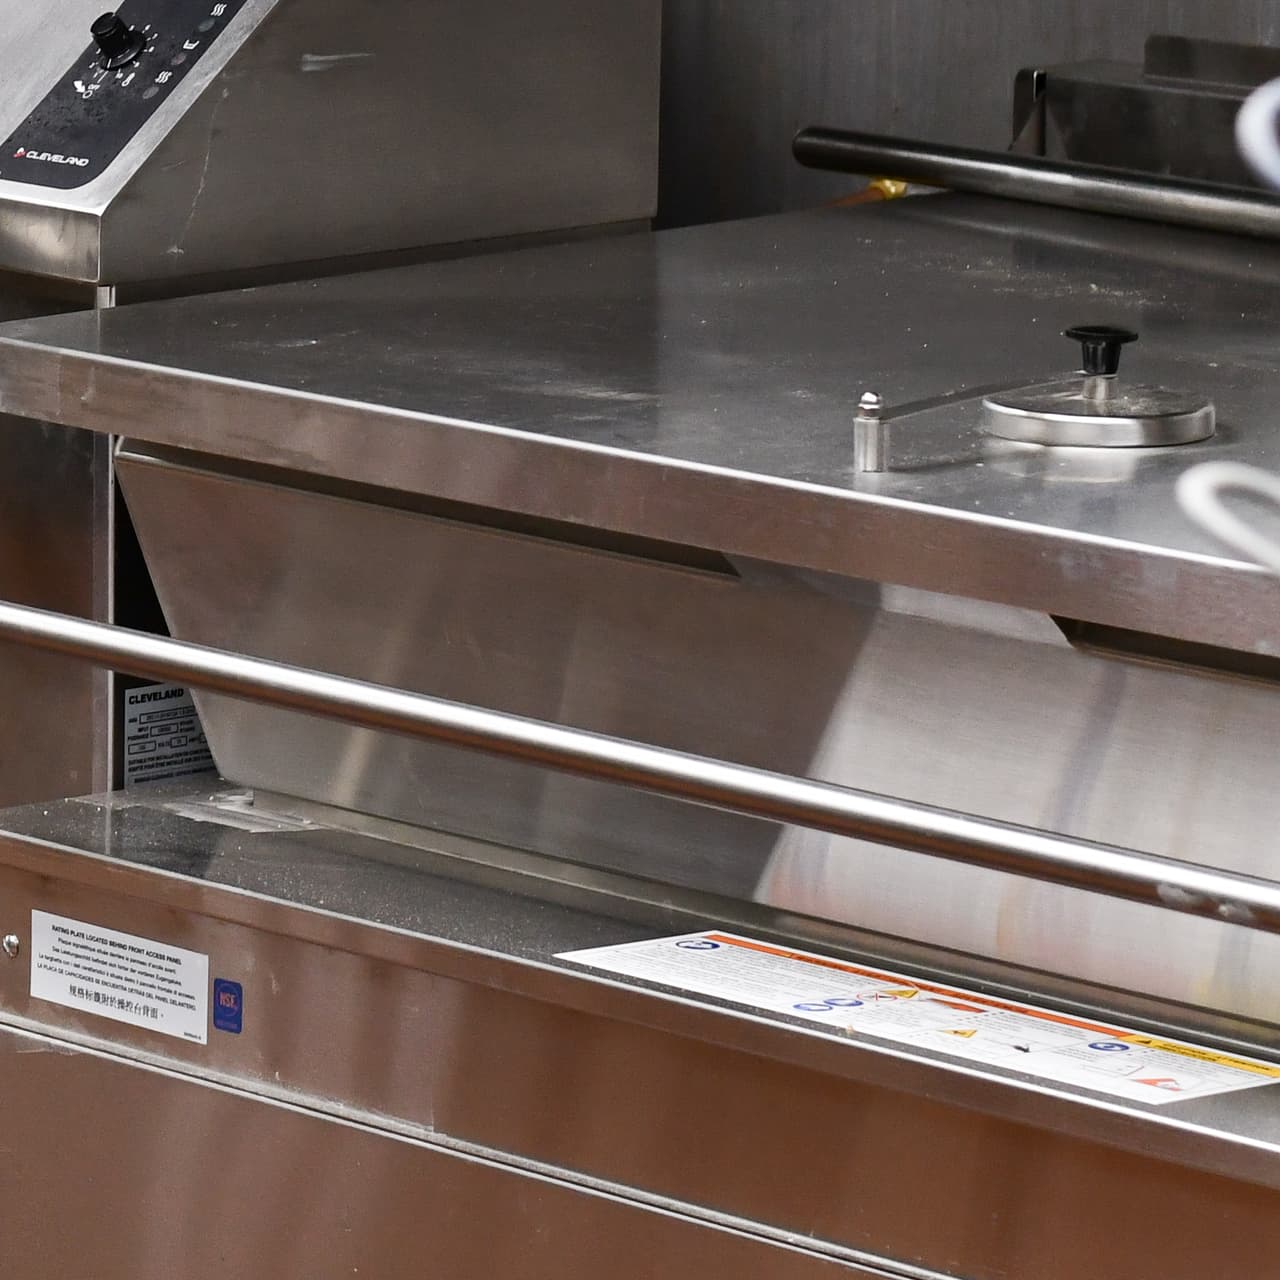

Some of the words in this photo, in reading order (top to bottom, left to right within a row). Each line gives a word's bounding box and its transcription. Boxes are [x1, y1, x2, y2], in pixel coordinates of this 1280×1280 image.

[26, 150, 89, 167] CLEVELAND
[128, 688, 185, 705] CLEVELAND
[52, 925, 69, 935] RATING
[70, 929, 84, 938] PLATE
[86, 933, 107, 945] LOCATED
[109, 939, 126, 950] BEHIND
[128, 944, 144, 954] FRONT
[146, 949, 165, 960] ACCESS
